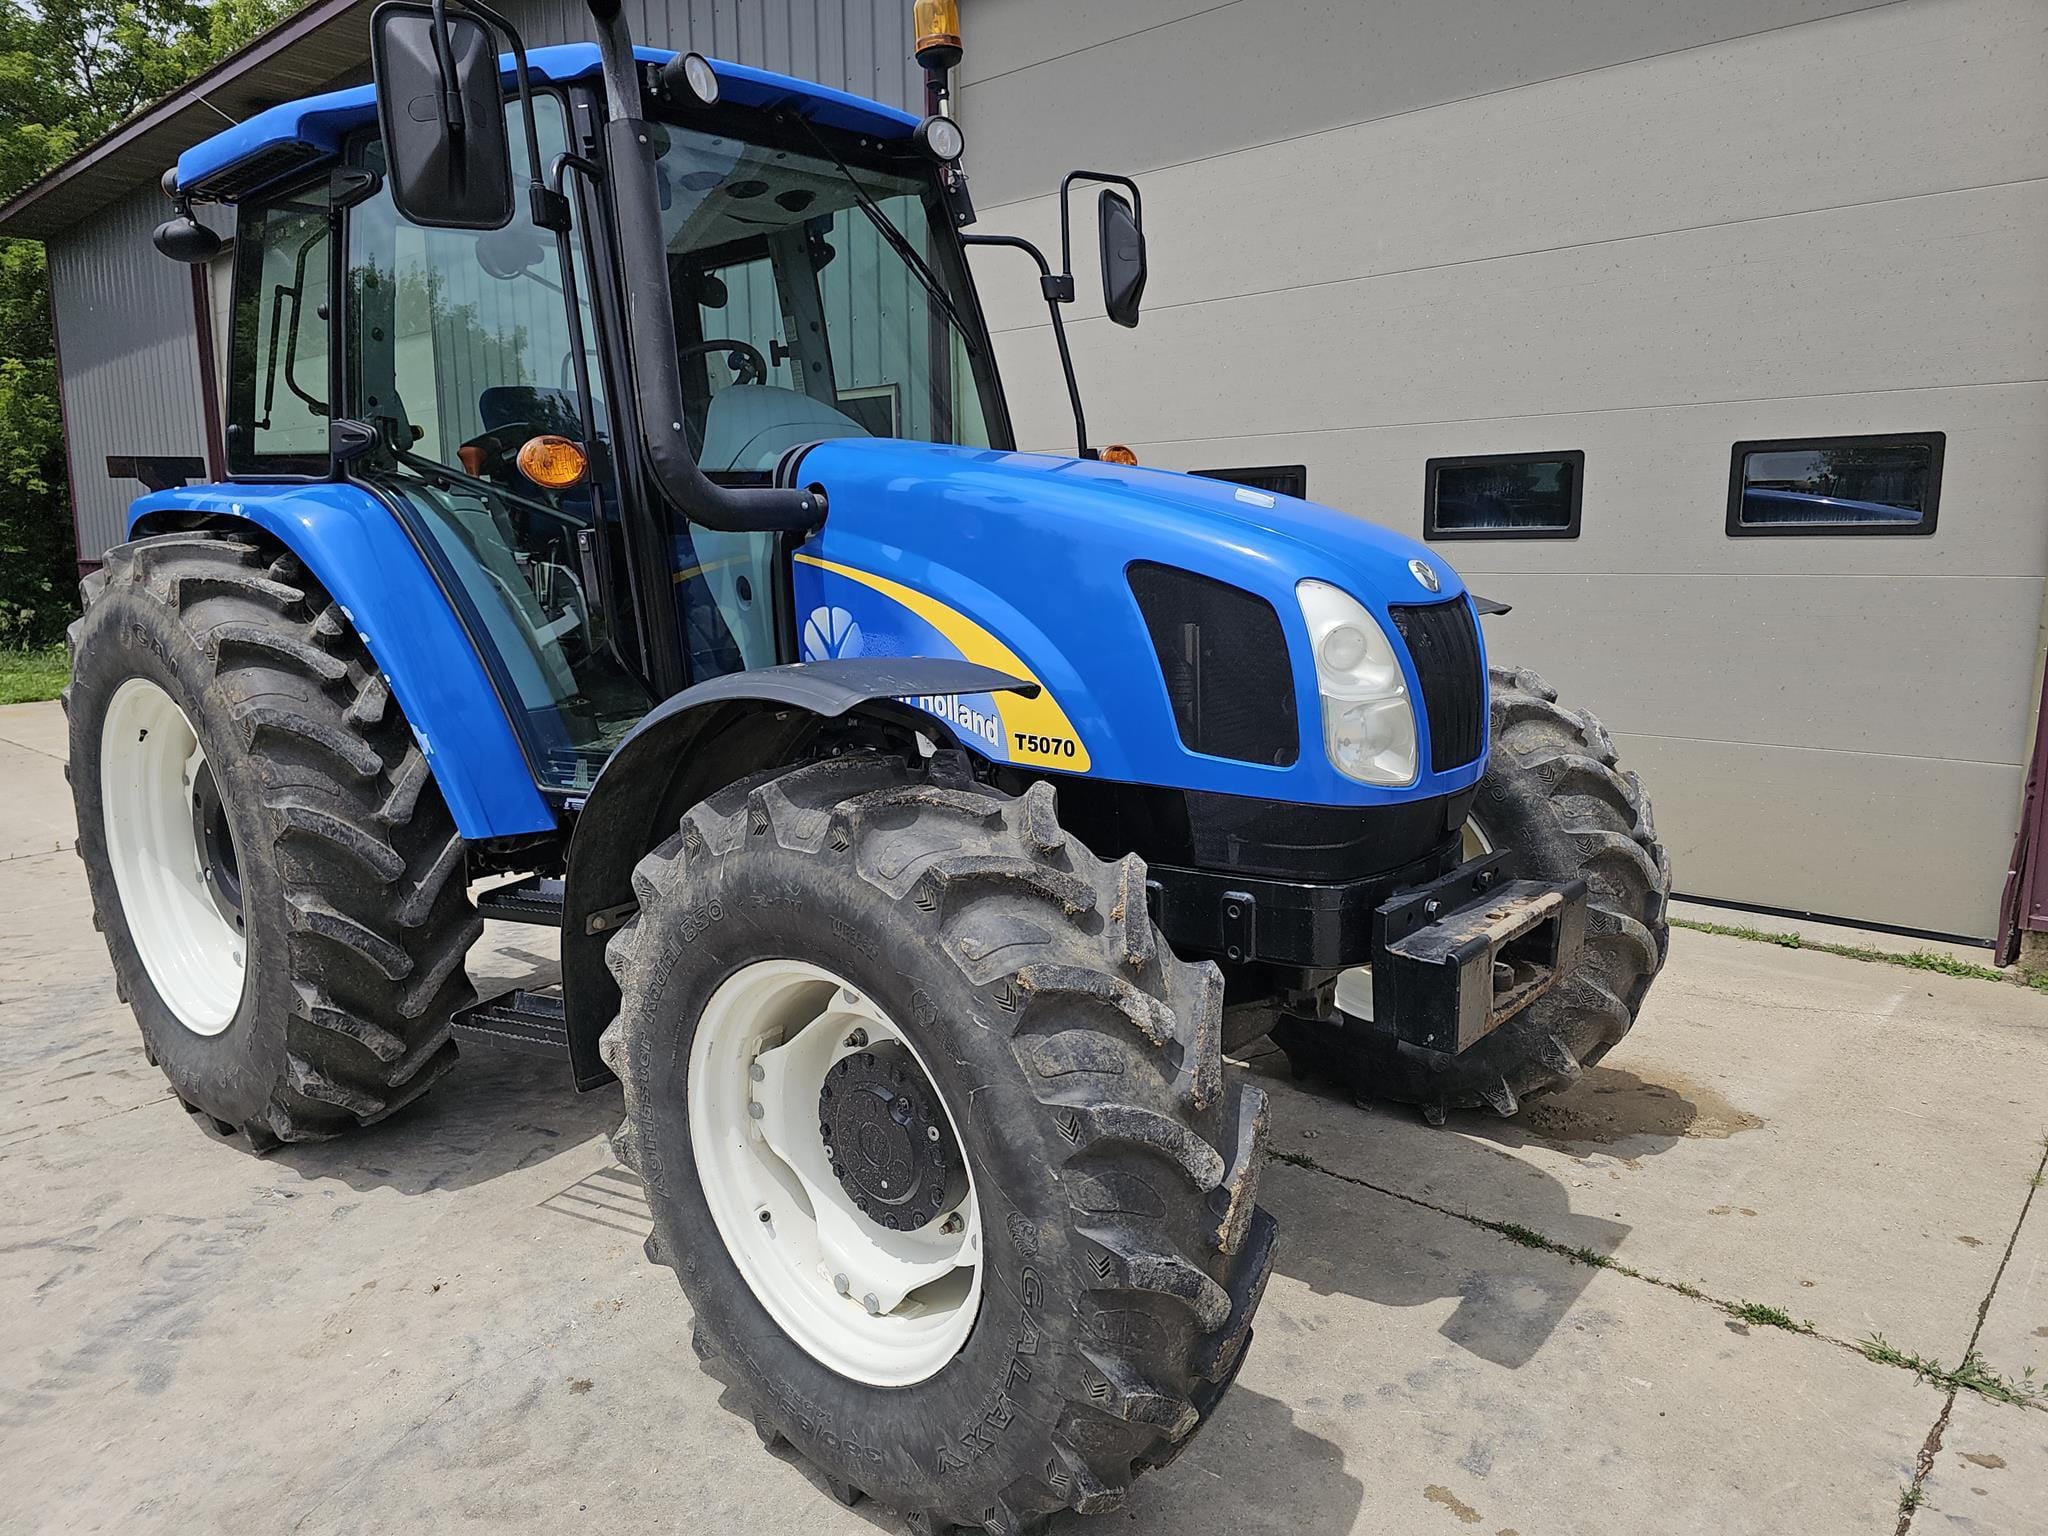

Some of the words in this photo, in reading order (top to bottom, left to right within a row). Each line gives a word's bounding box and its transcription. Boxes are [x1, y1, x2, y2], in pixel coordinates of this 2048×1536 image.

[918, 694, 999, 748] Holland
[1014, 733, 1076, 758] T5070
[641, 935, 683, 1023] Radial
[678, 898, 725, 943] 850
[936, 1266, 1045, 1474] GALAXY
